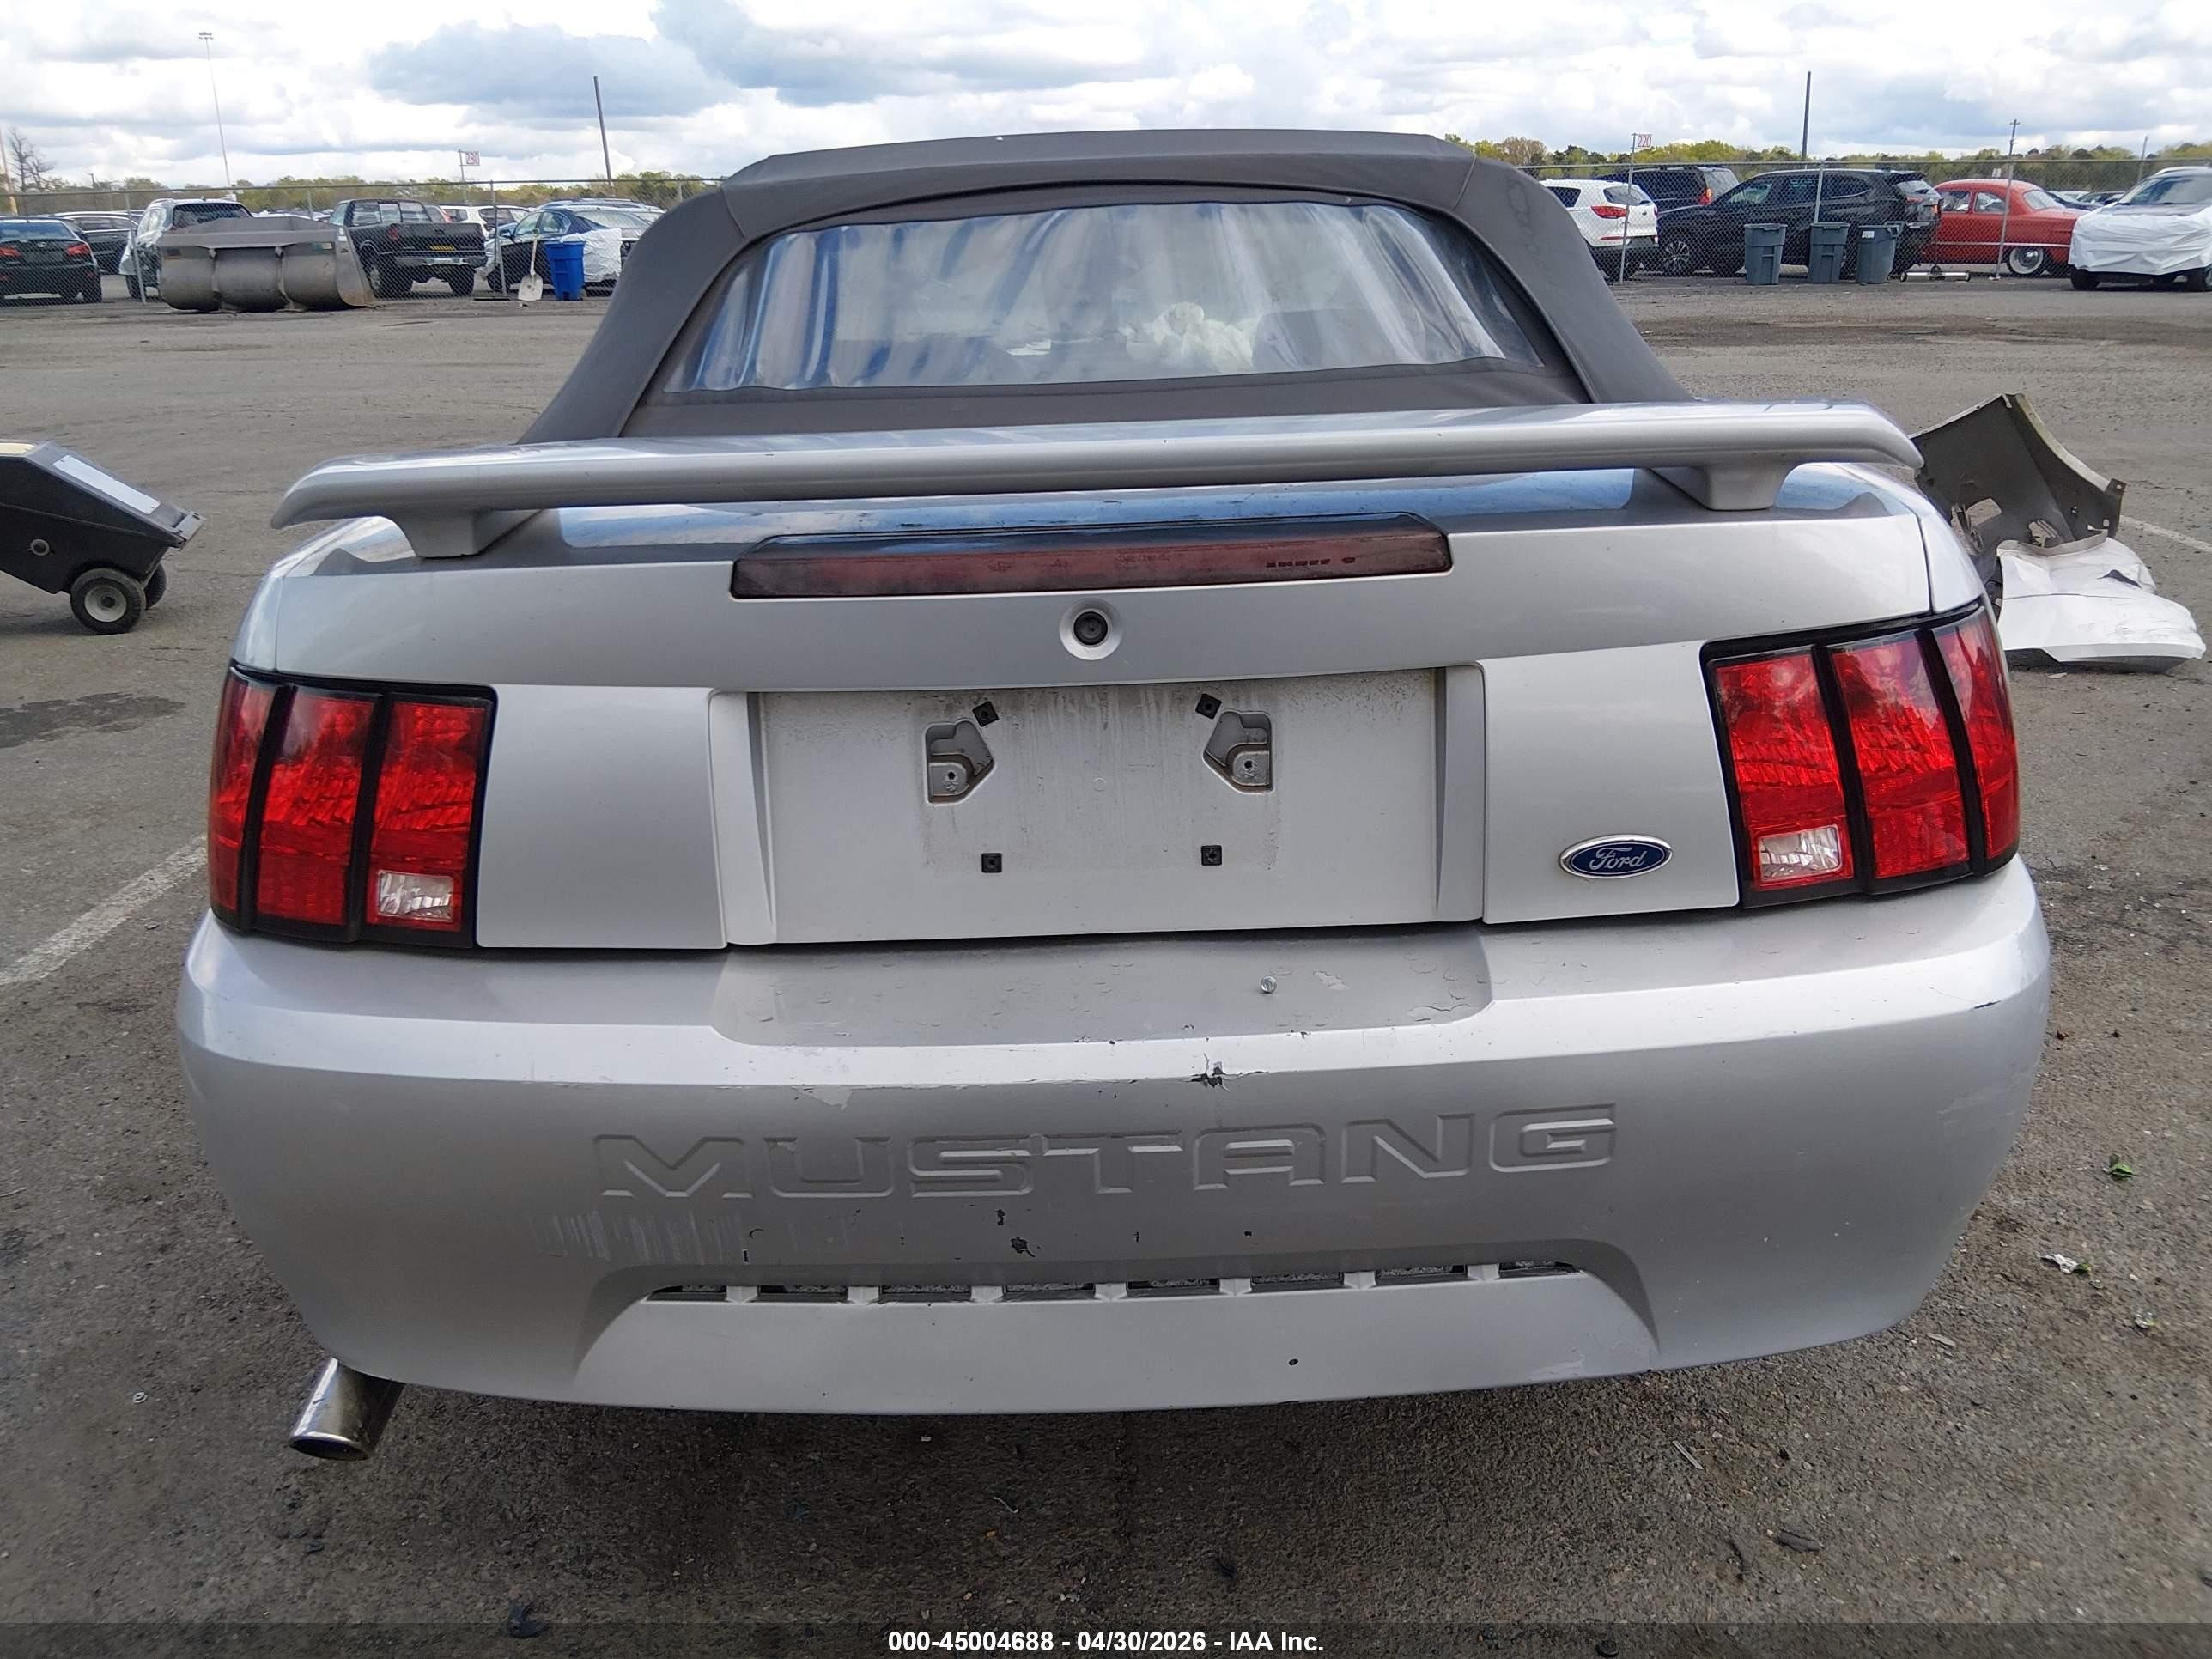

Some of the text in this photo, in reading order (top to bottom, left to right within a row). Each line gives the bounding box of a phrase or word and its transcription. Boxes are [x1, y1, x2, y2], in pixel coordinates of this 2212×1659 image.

[1637, 135, 1652, 147] 220
[1589, 847, 1648, 870] Ford
[592, 1103, 1616, 1199] MUSTANG
